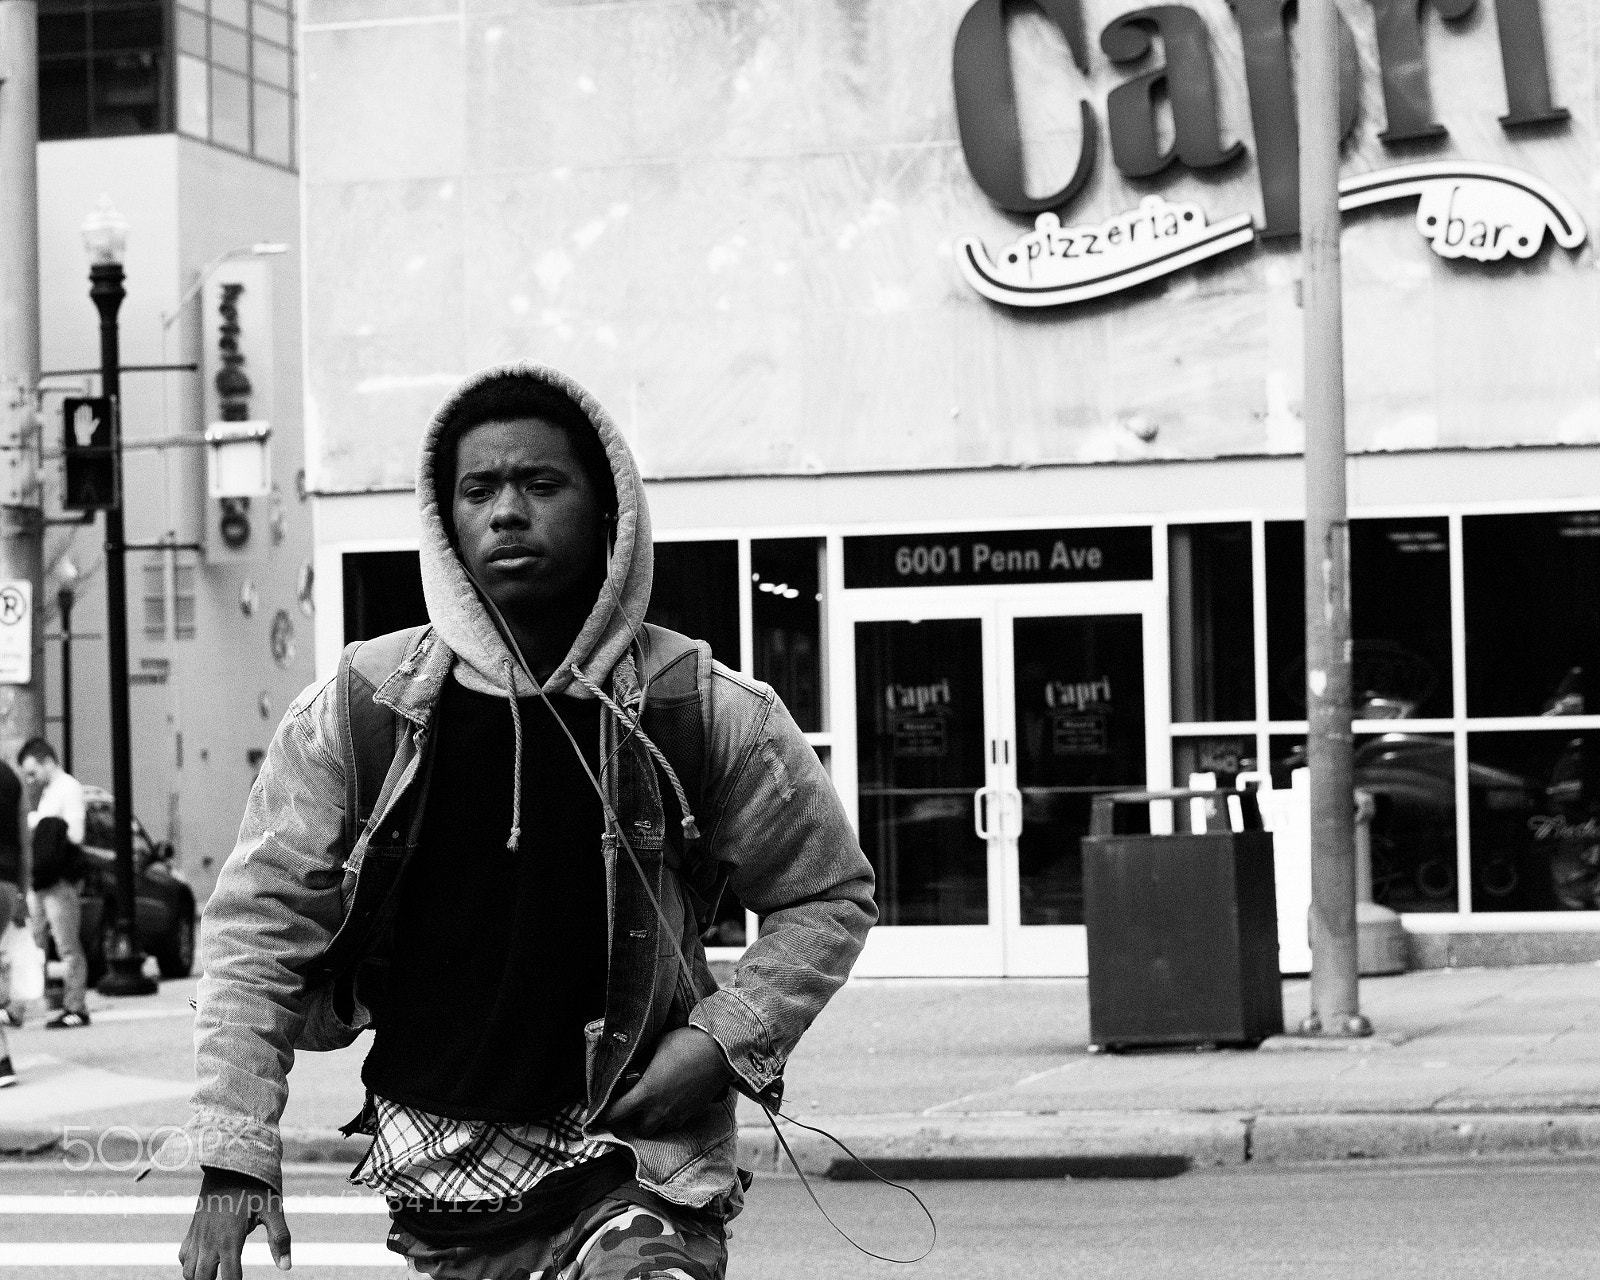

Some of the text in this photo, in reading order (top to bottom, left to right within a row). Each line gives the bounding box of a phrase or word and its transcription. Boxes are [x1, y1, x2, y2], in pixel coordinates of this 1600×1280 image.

[1026, 204, 1179, 281] pizzeria
[1445, 186, 1512, 248] bar
[895, 541, 1103, 575] 6001 Penn Ave
